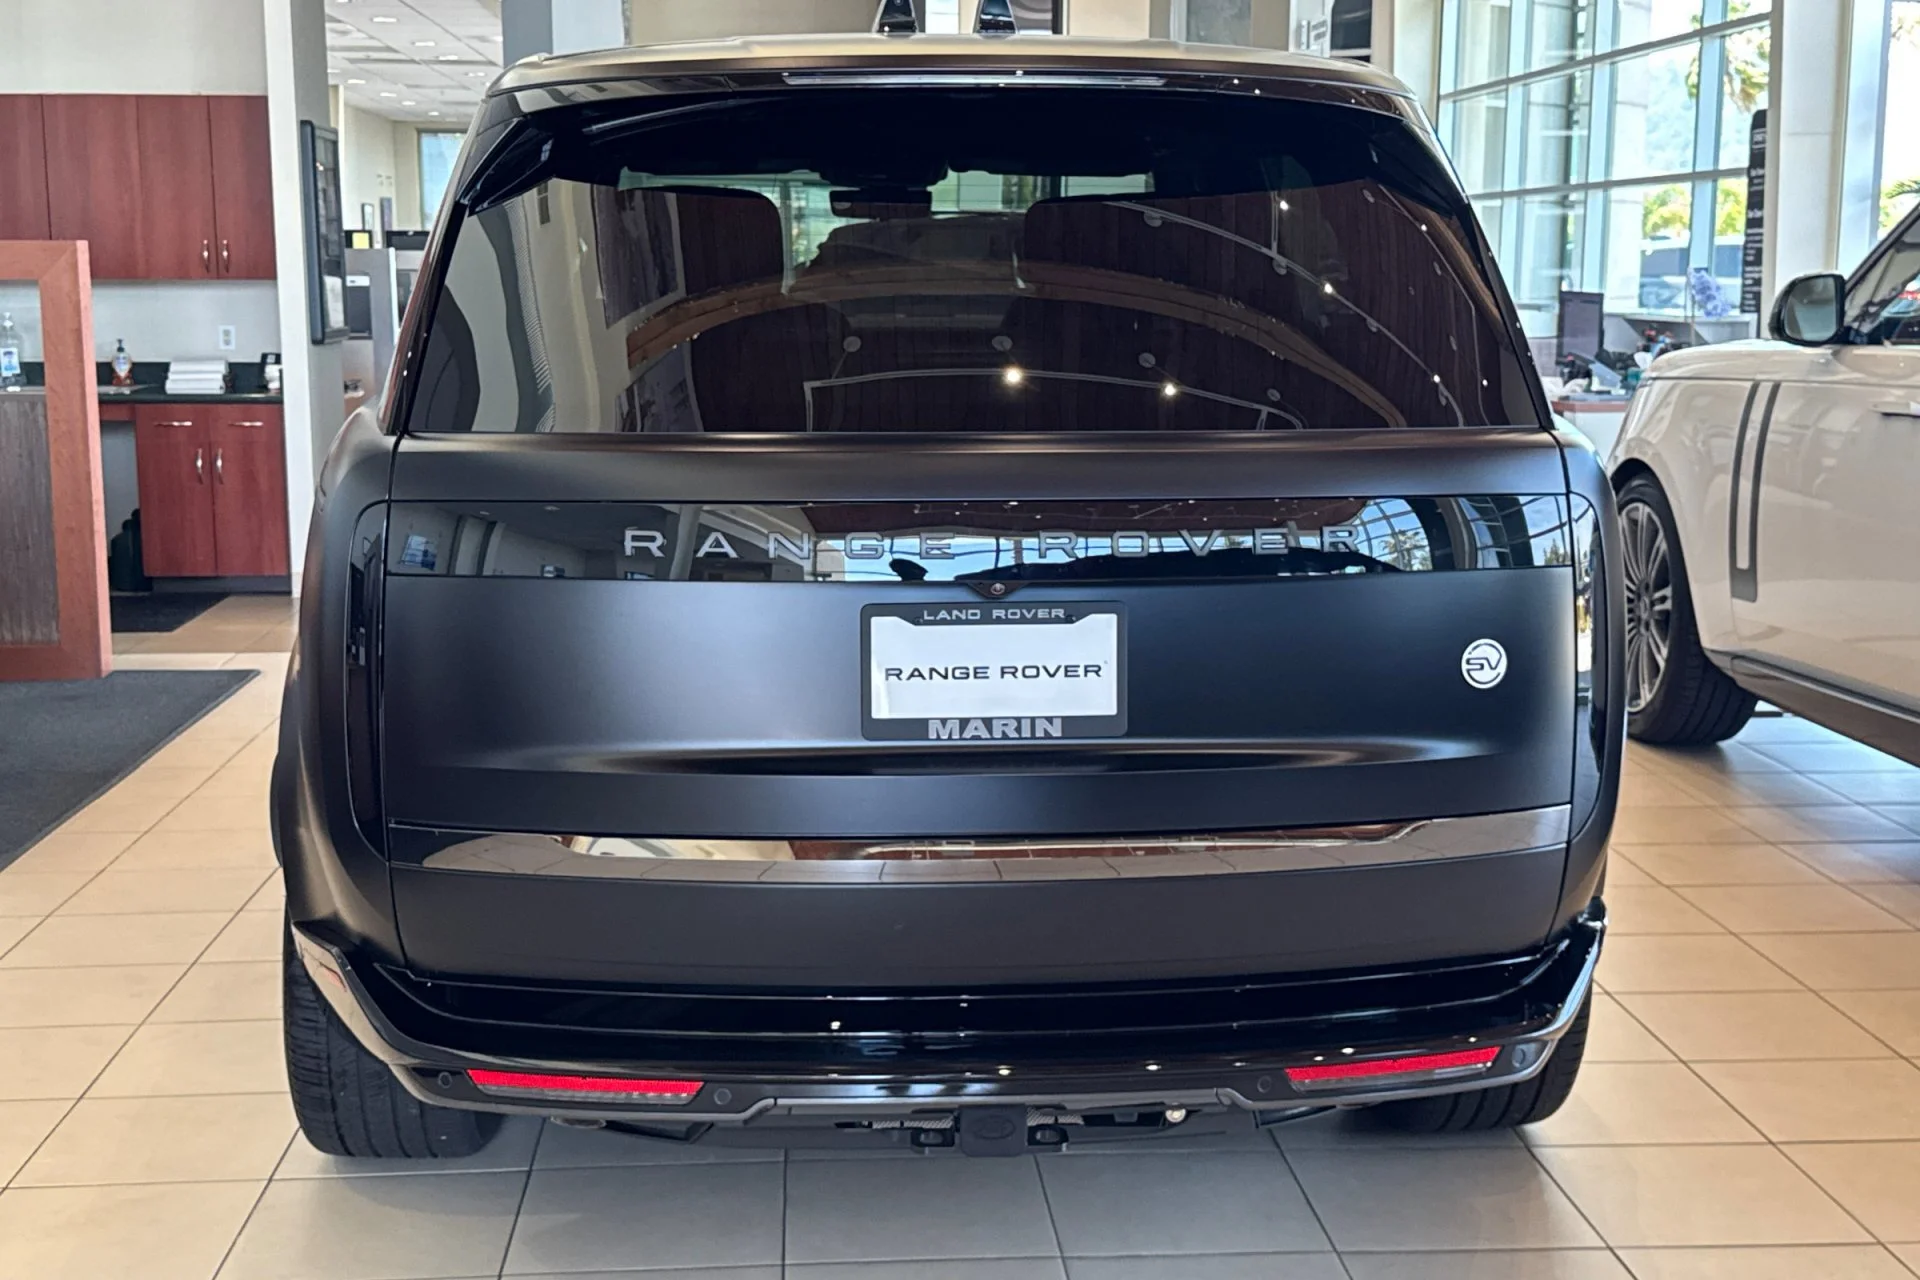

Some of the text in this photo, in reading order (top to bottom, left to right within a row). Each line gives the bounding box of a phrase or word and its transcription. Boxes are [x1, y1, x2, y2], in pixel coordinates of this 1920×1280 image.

[624, 525, 1359, 559] RANGE ROVER
[923, 608, 1065, 620] LAND ROVER
[885, 664, 1102, 681] RANGE ROVER
[928, 717, 1062, 739] MARIN
